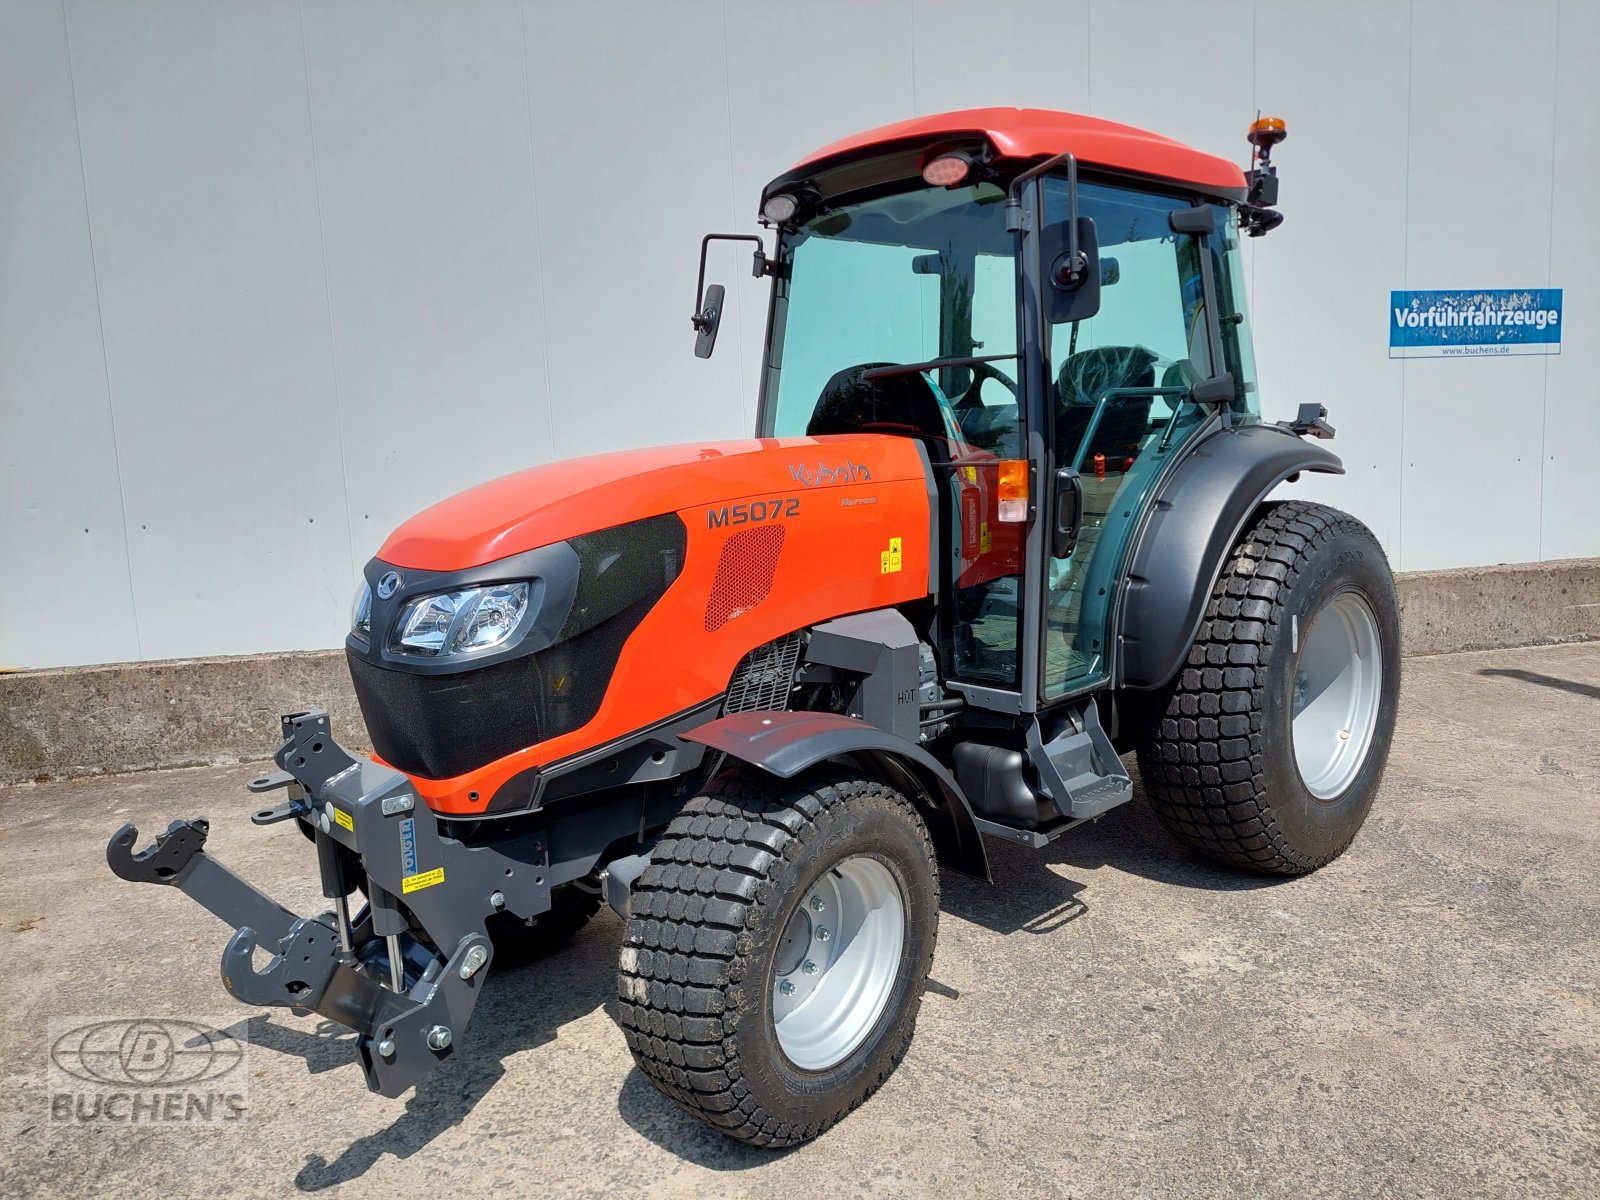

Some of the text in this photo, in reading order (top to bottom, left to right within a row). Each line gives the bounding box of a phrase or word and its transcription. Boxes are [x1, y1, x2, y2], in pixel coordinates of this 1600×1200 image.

[1395, 306, 1558, 330] Vorführfahrzeuge
[1442, 346, 1510, 355] www.buchens.de
[789, 459, 871, 486] Kubota
[707, 498, 800, 529] M5072
[897, 688, 915, 704] HOT
[808, 824, 854, 868] MOW
